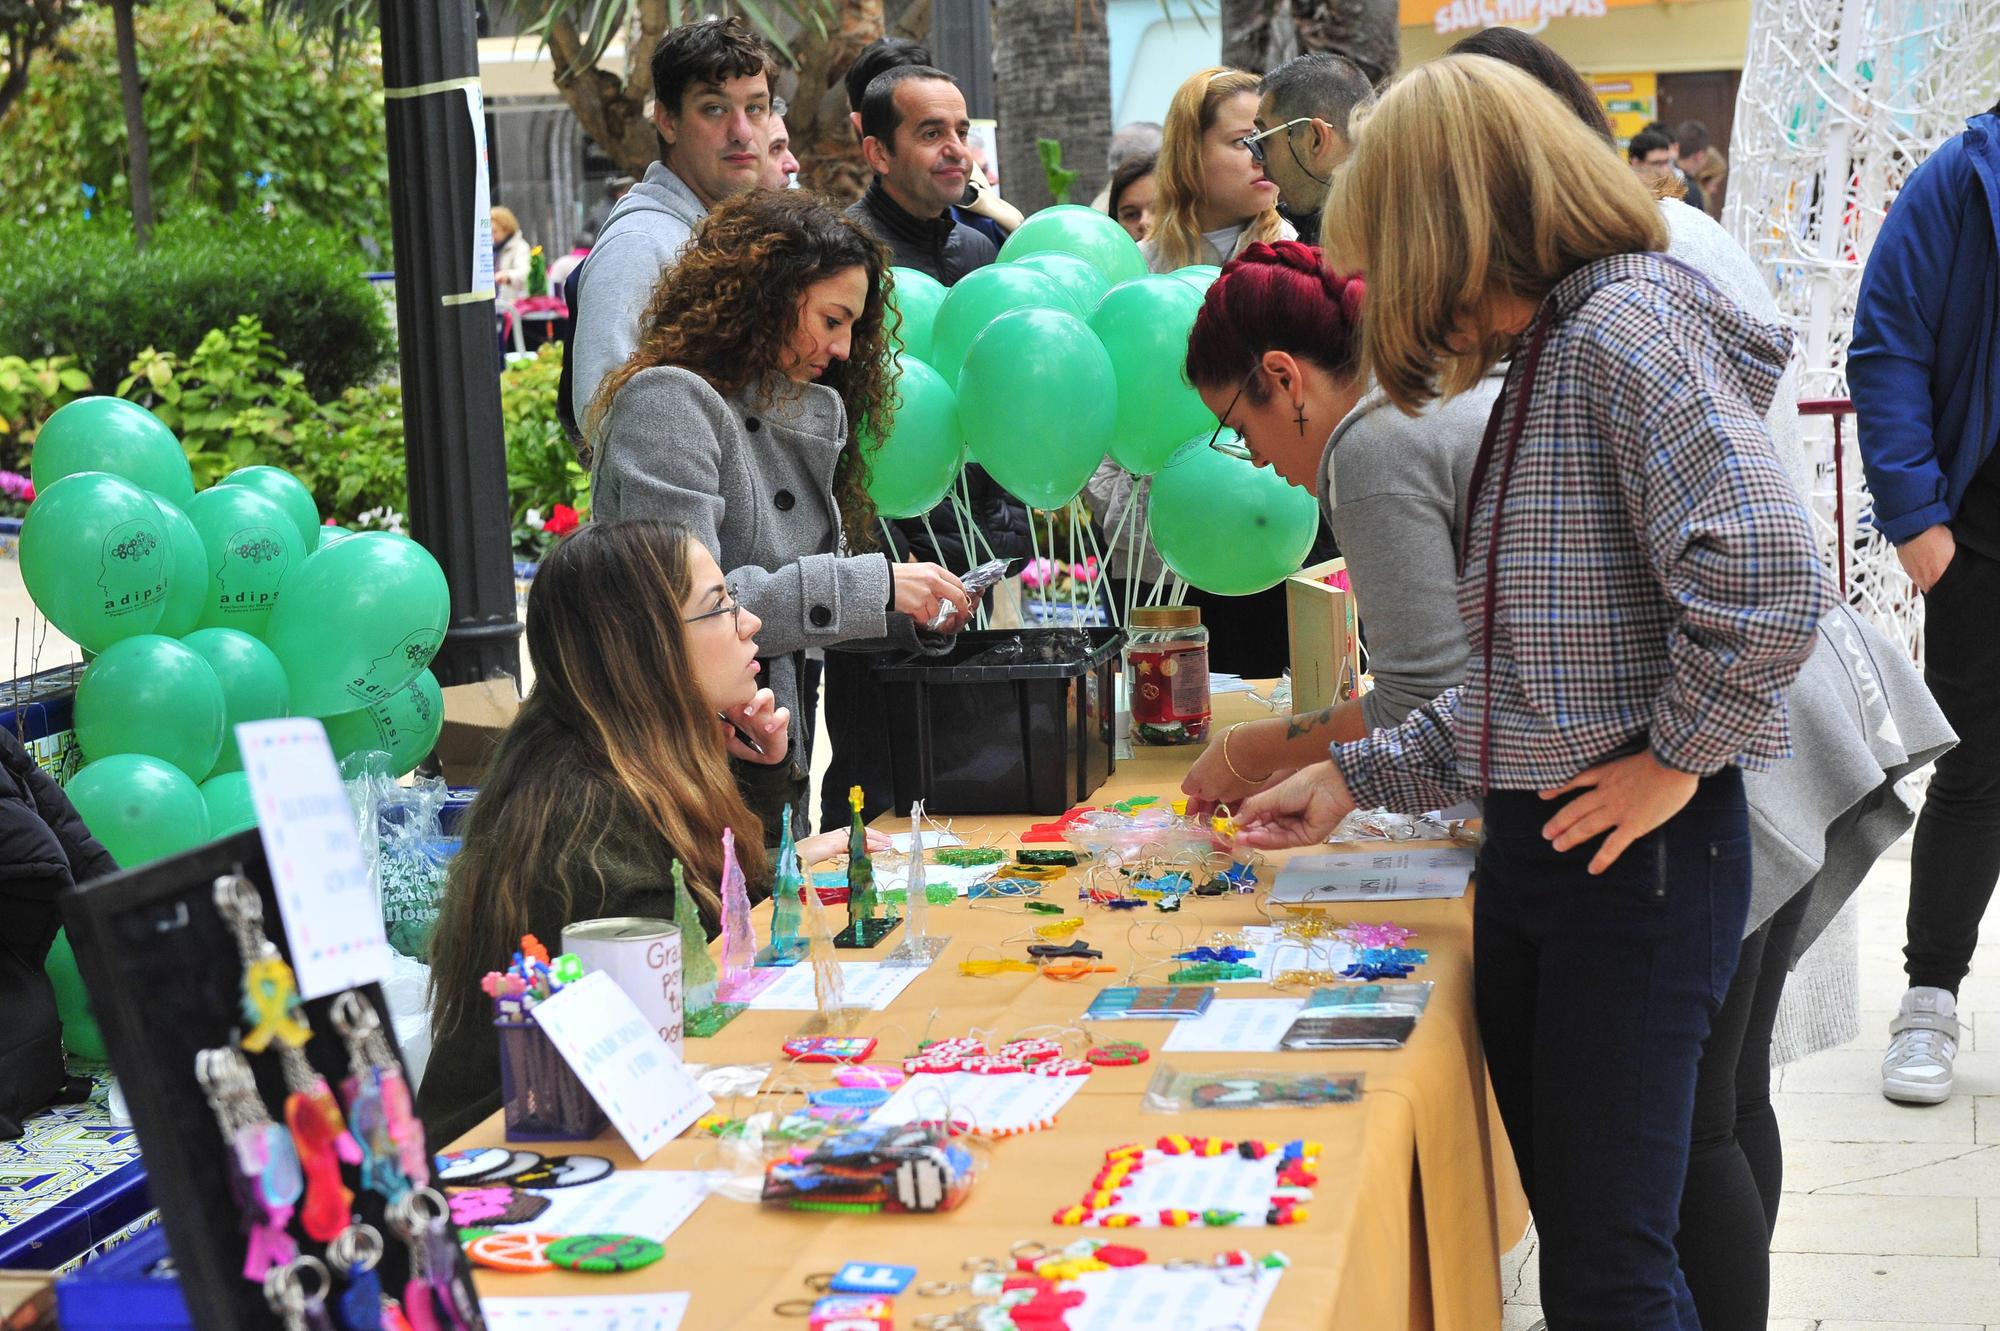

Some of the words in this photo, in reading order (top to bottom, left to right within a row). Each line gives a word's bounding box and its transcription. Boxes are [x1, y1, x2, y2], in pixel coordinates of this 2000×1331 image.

[1434, 0, 1608, 34] SALCHIPAPAS
[104, 577, 168, 608] adipsi
[219, 591, 280, 603] adips
[647, 942, 680, 969] Gra
